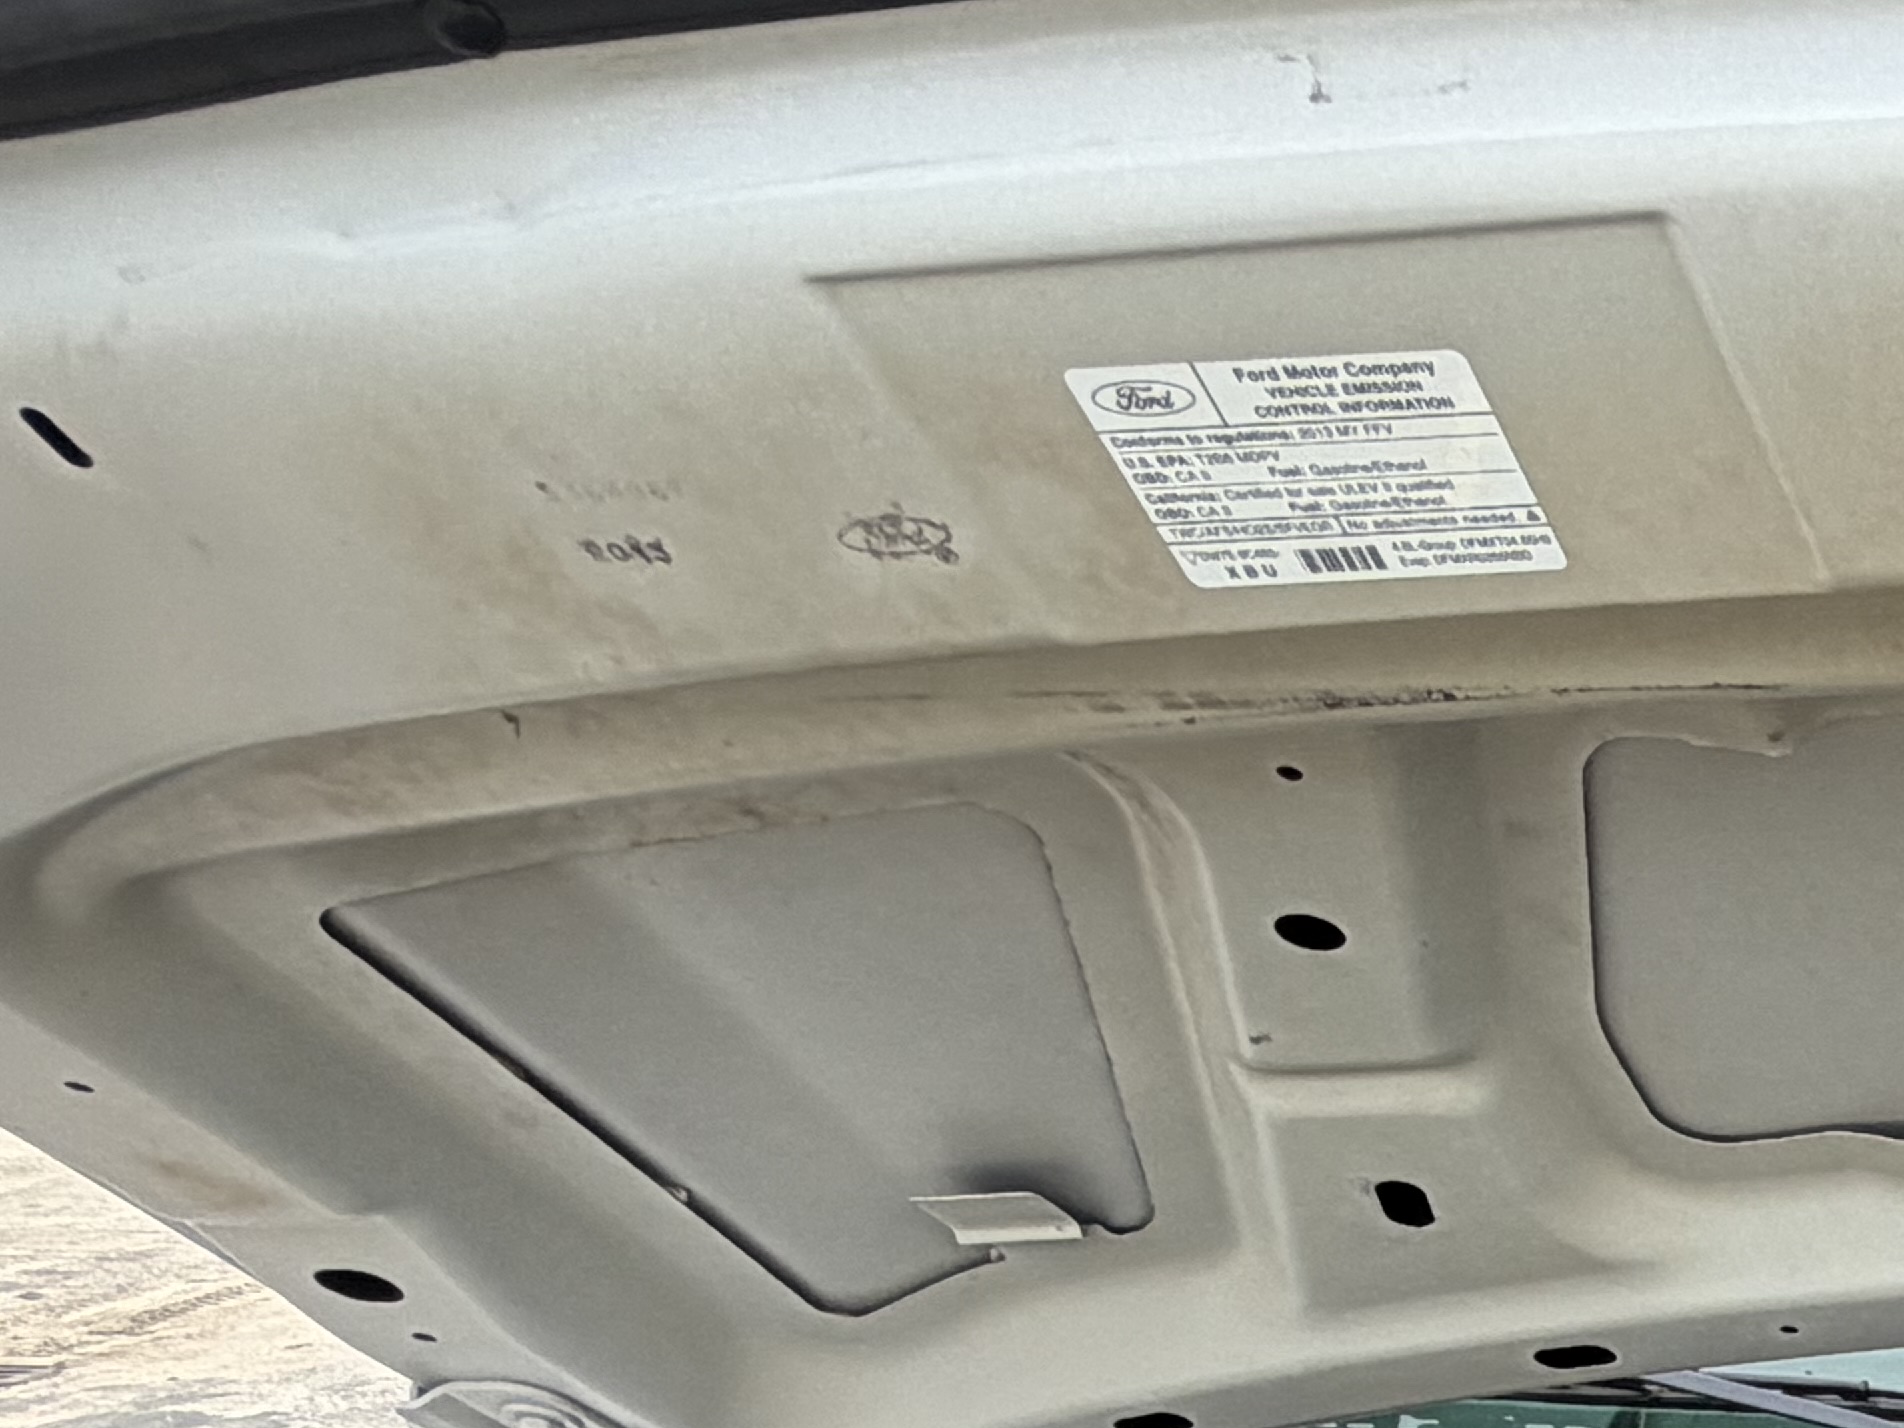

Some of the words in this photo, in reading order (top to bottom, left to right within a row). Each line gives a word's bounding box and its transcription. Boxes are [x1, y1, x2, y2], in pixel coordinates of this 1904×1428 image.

[1233, 367, 1280, 383] Ford
[1283, 364, 1339, 380] Motor
[1343, 360, 1436, 379] Company
[1115, 385, 1176, 411] Ford
[1264, 385, 1339, 399] VEHICLE
[1342, 381, 1424, 396] EMISSION
[1254, 402, 1336, 418] CONTROL
[1339, 396, 1456, 414] INFORMATION
